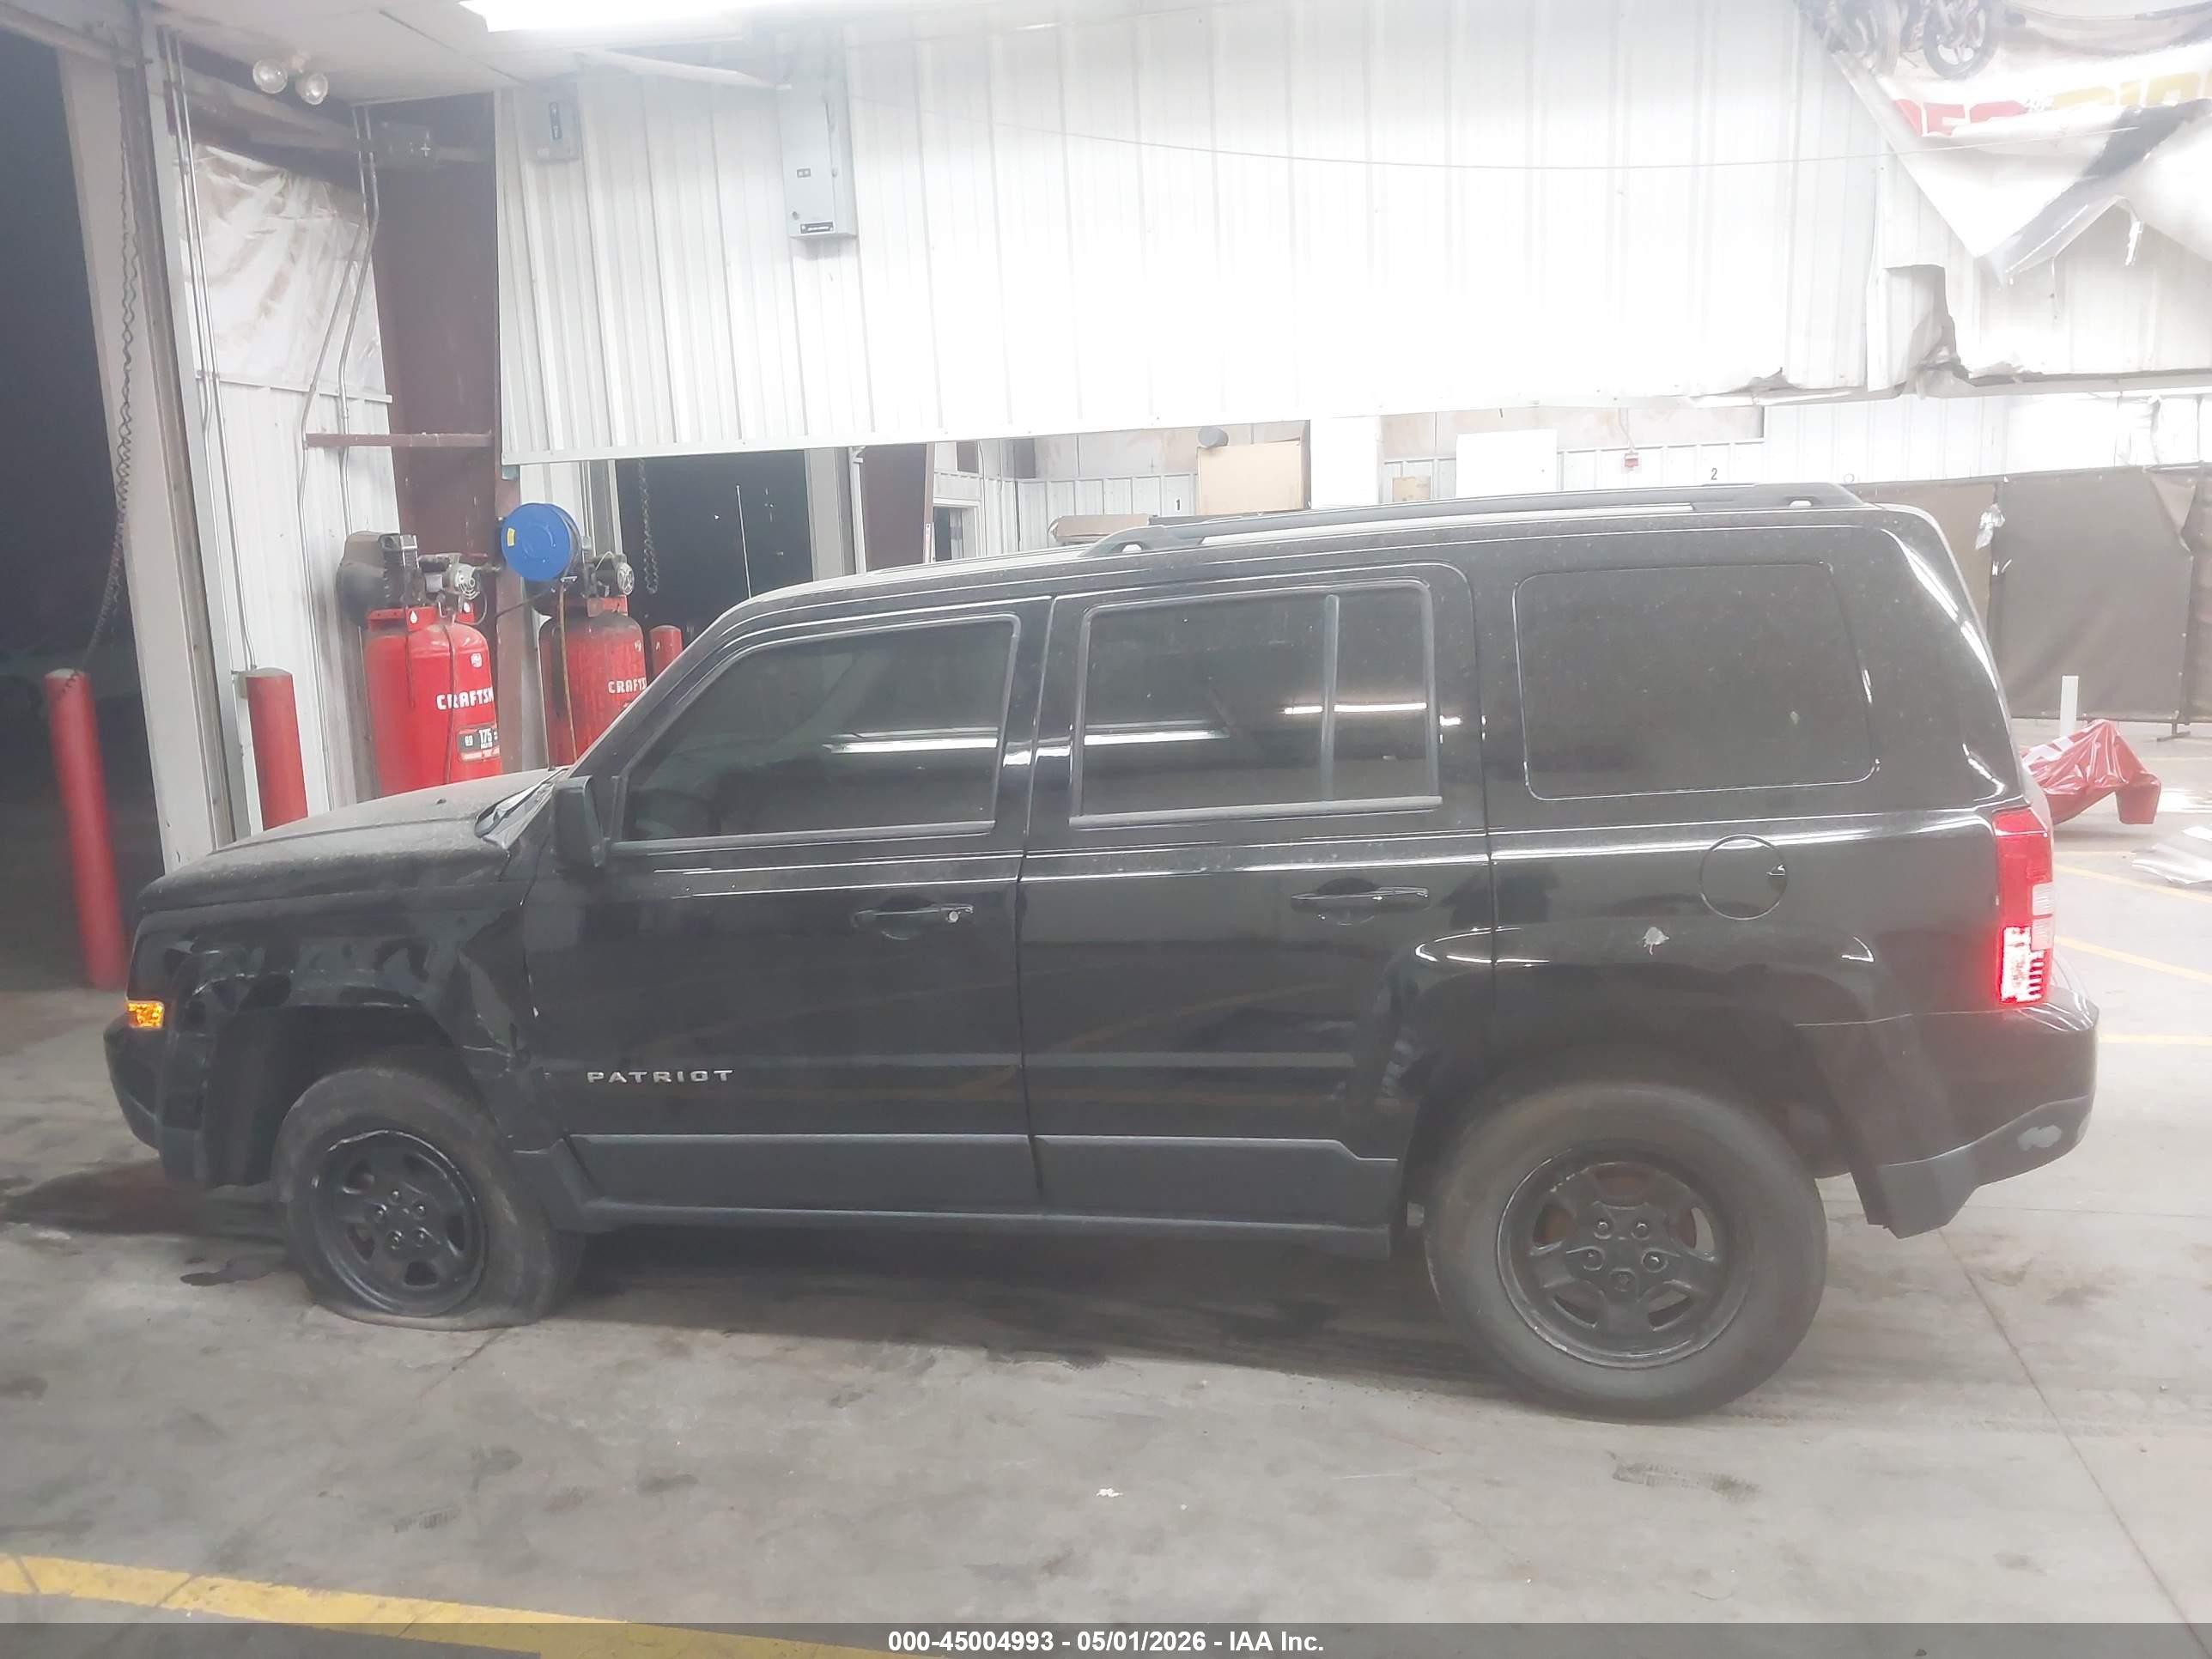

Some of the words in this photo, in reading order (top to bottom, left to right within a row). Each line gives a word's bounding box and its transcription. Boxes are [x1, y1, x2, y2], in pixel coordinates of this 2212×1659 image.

[1711, 467, 1718, 481] 2
[1176, 498, 1181, 511] 1
[586, 1070, 733, 1084] PATRIOT
